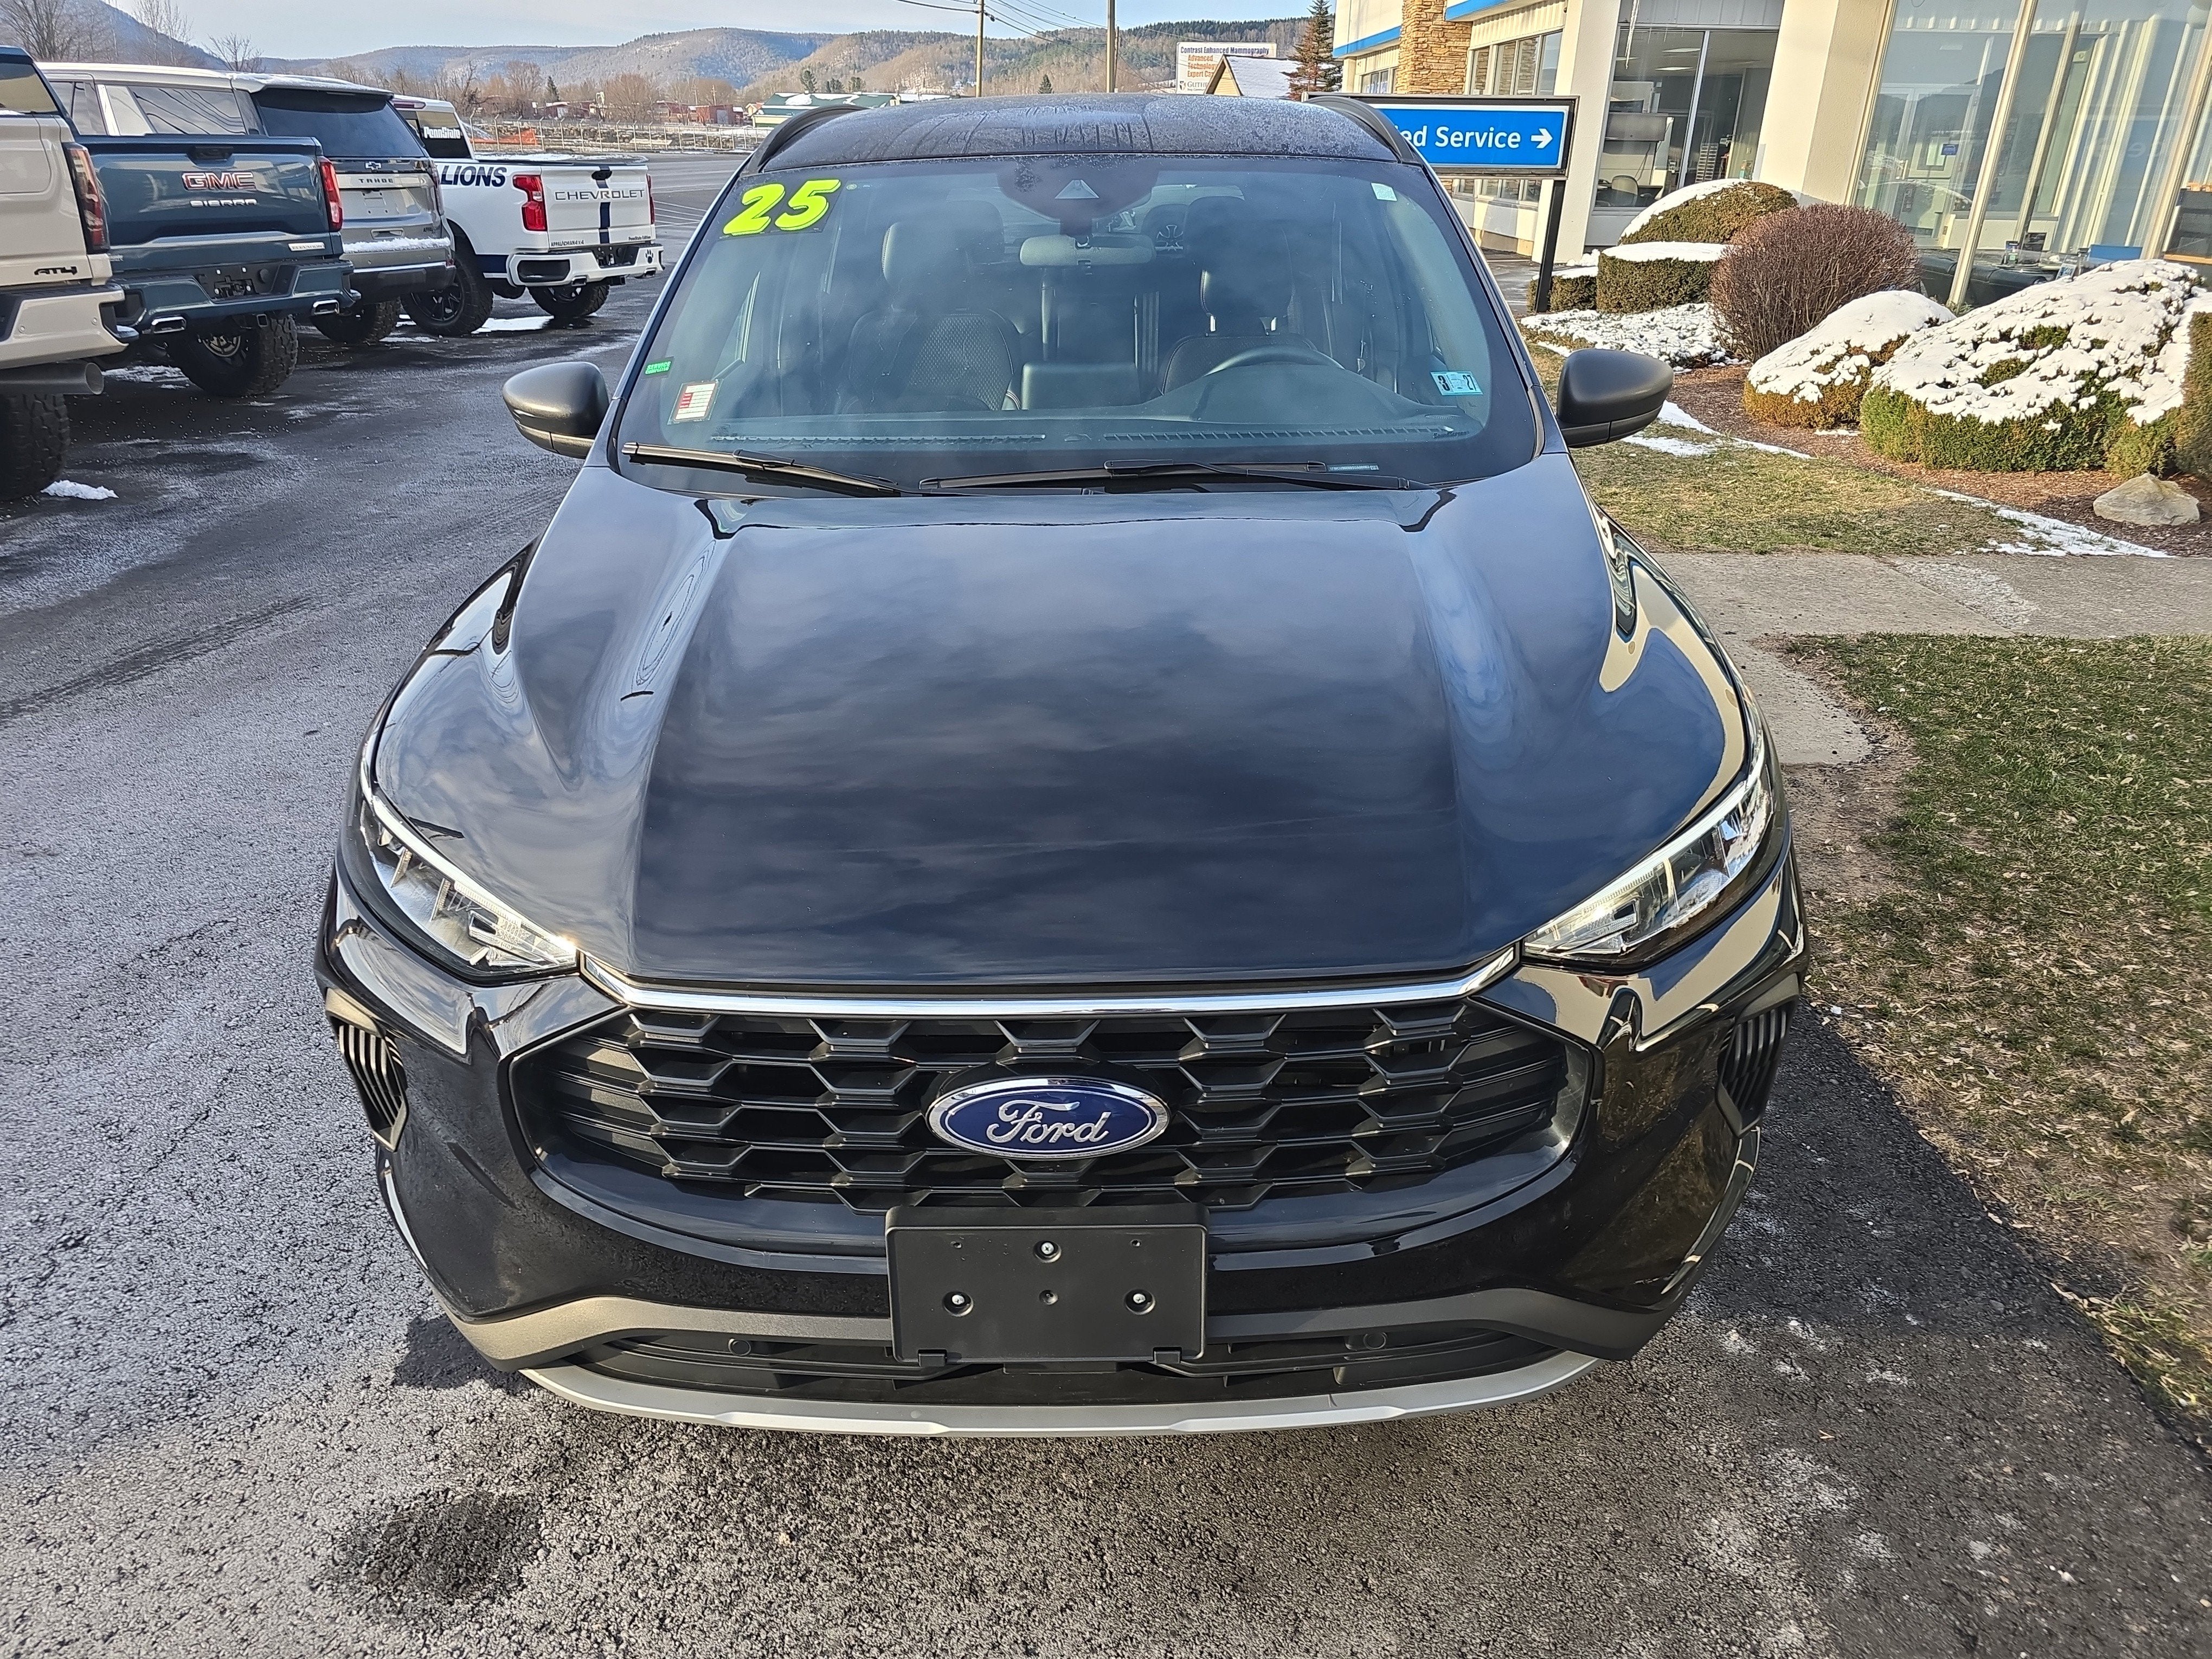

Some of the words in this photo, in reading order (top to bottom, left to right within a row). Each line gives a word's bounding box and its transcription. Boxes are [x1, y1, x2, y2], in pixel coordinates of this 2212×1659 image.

[1395, 125, 1427, 147] ed
[1435, 126, 1521, 149] Service
[182, 171, 258, 190] GMC
[440, 165, 507, 187] LIONS
[190, 198, 257, 207] SIERRA
[555, 190, 645, 200] CHEVROLET
[723, 179, 841, 236] 25
[34, 266, 78, 275] AT4
[1437, 375, 1450, 391] 3
[1462, 375, 1477, 391] 27
[986, 1099, 1111, 1143] Ford
